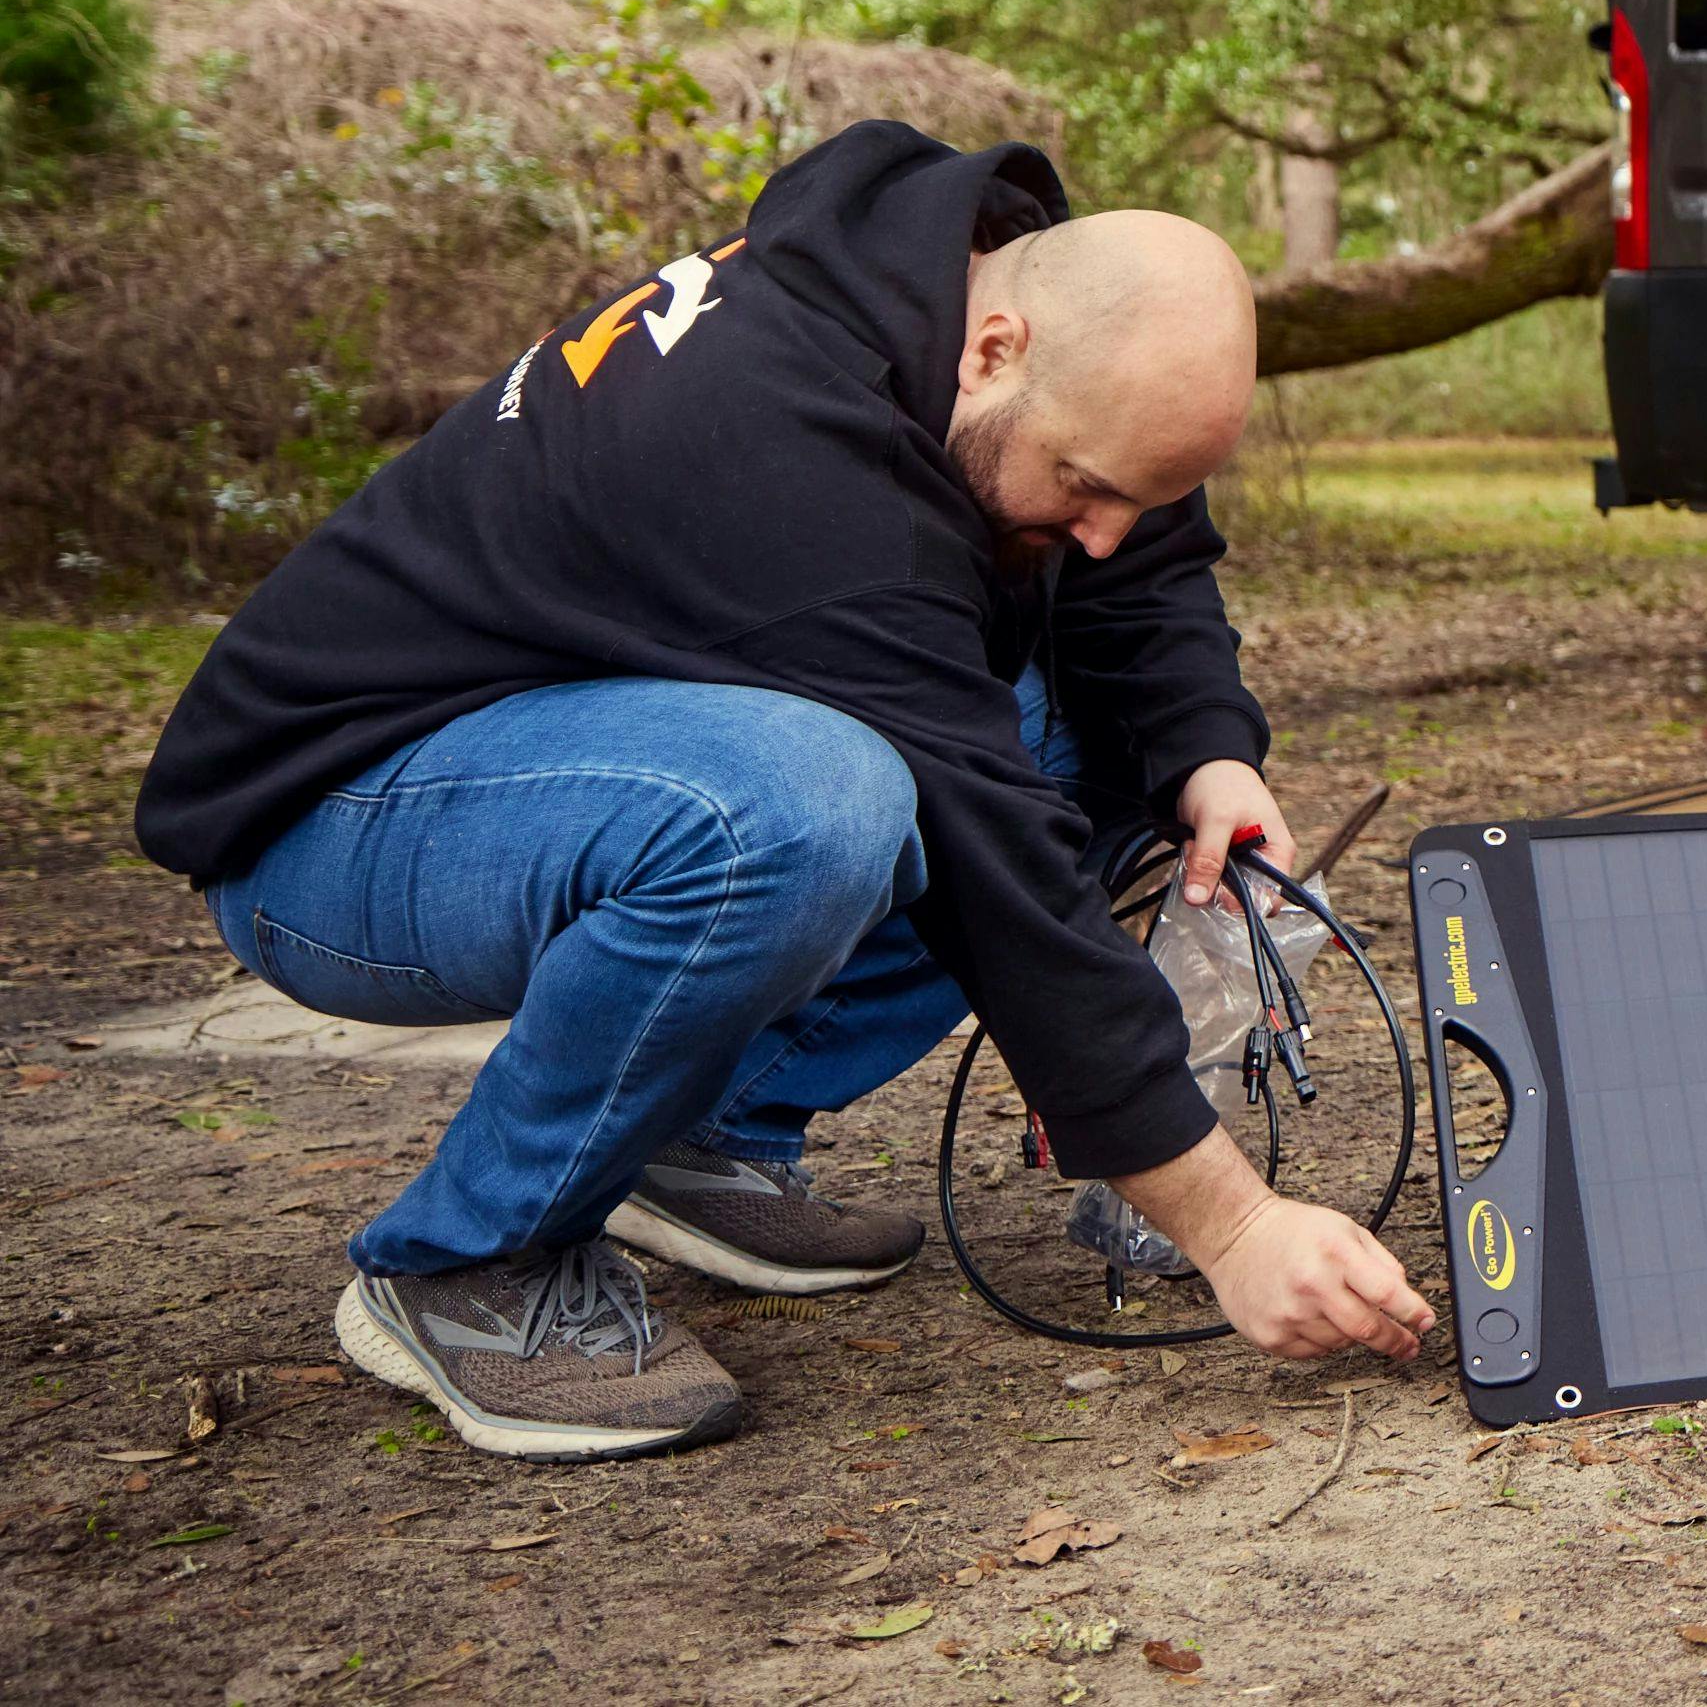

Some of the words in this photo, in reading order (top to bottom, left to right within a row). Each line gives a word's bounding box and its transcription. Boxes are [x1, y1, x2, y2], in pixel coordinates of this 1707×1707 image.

[1445, 915, 1478, 1005] gpelectric.com
[1481, 1209, 1496, 1255] Power!
[1486, 1257, 1498, 1275] Go
